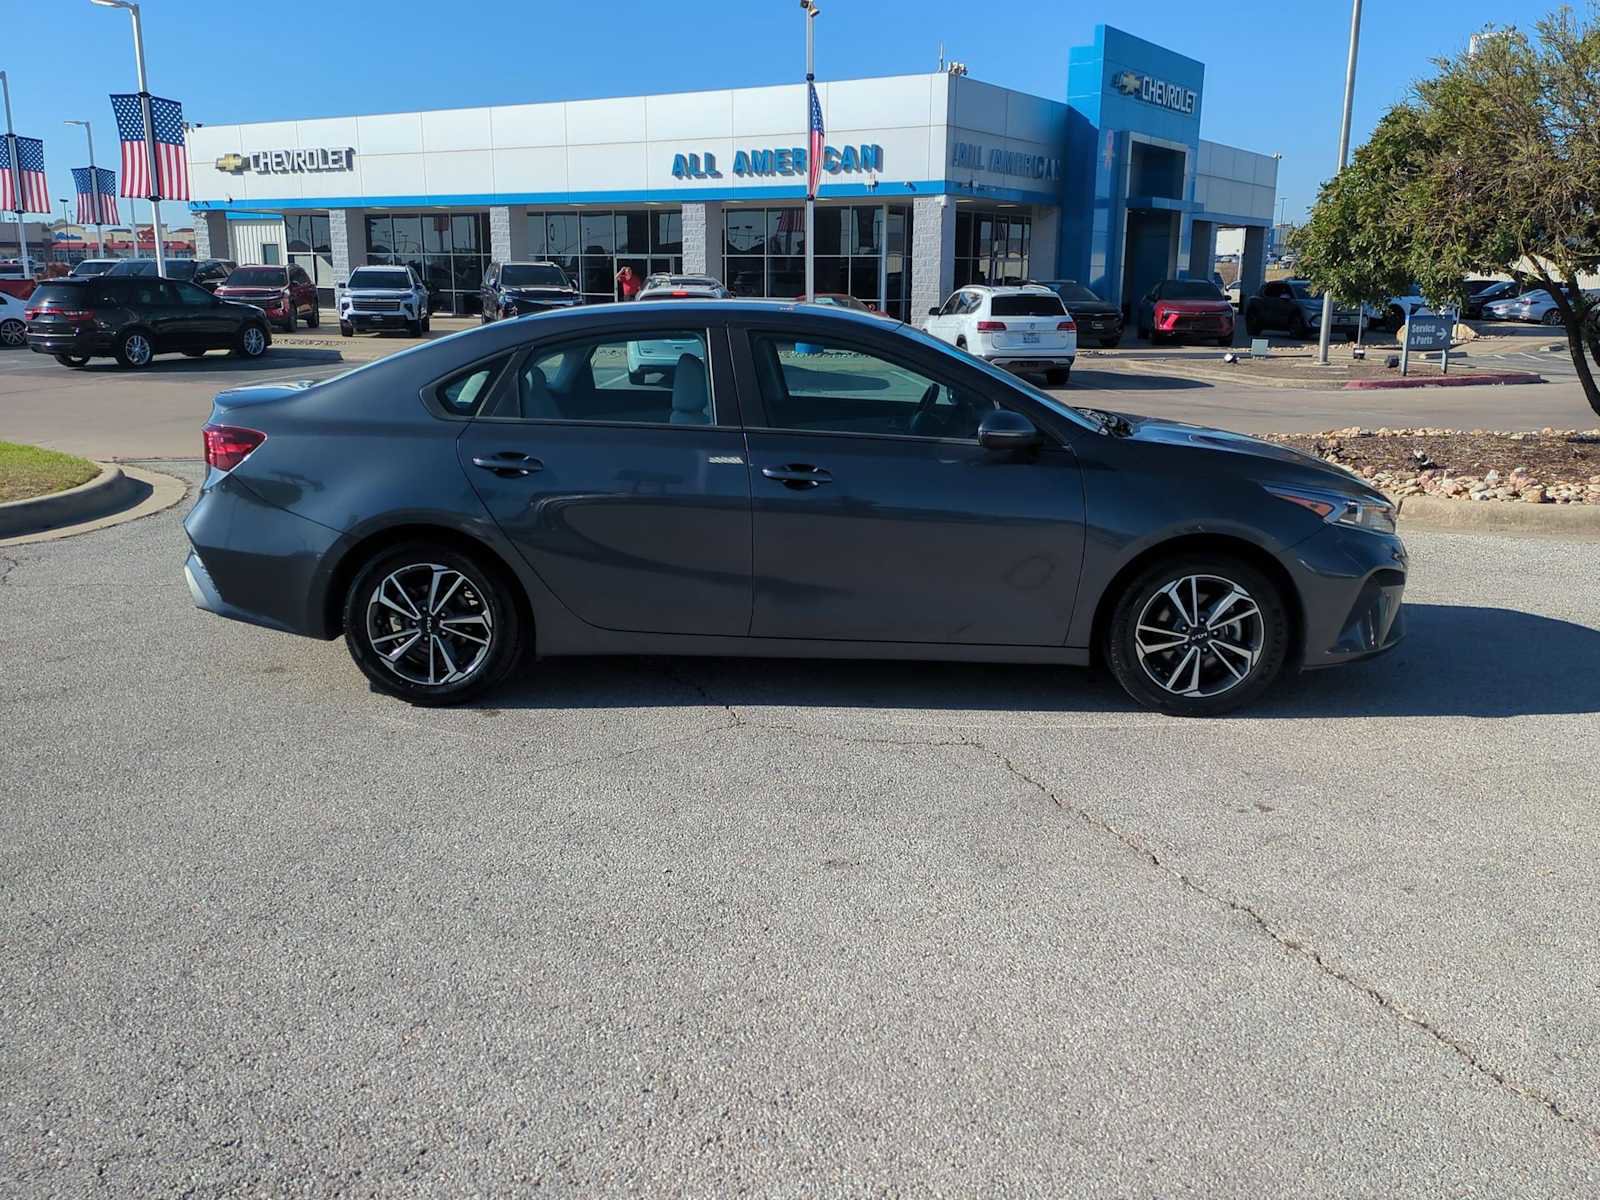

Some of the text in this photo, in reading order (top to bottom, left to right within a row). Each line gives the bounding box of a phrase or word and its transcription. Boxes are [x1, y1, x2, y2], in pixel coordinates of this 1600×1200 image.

[1142, 75, 1197, 113] CHEVROLET
[249, 147, 354, 173] CHEVROLET
[672, 144, 884, 180] ALL AMERCAN
[1411, 323, 1436, 333] Service
[1416, 335, 1433, 345] Parts
